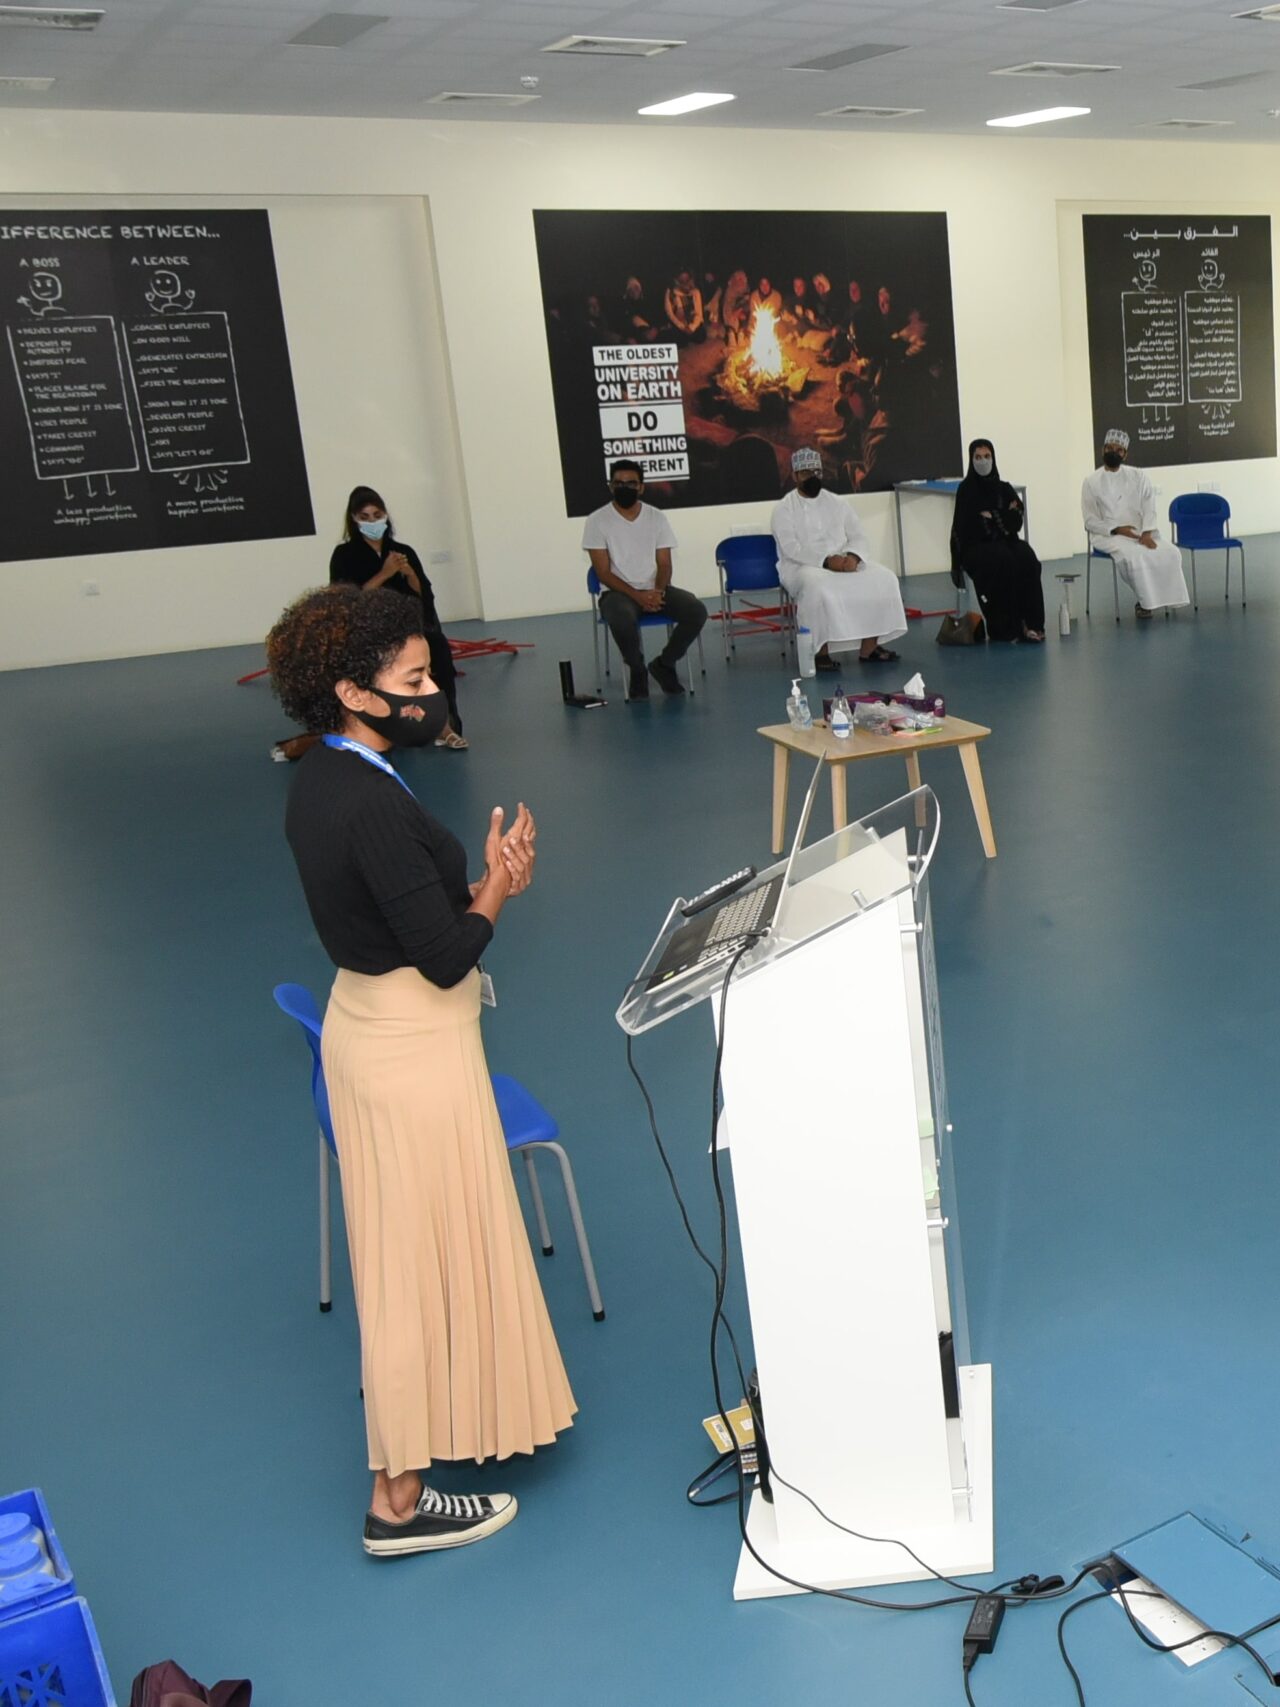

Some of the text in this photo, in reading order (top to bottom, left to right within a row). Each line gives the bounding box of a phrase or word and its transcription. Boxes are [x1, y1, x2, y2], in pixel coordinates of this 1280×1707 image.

[0, 226, 220, 240] IFFERENCE BETWEEN...
[1184, 225, 1238, 240] الفرق
[20, 258, 60, 268] A BOSS
[130, 256, 190, 266] A LEADER
[598, 347, 672, 360] THE OLDEST
[594, 365, 679, 382] UNIVERSITY
[597, 380, 682, 401] ON EARTH
[627, 410, 658, 432] DO
[603, 437, 688, 456] SOMETHING
[640, 458, 684, 473] ERENT
[200, 496, 244, 508] productive
[202, 504, 245, 512] workforce
[86, 504, 132, 517] productive
[93, 512, 138, 521] workforce
